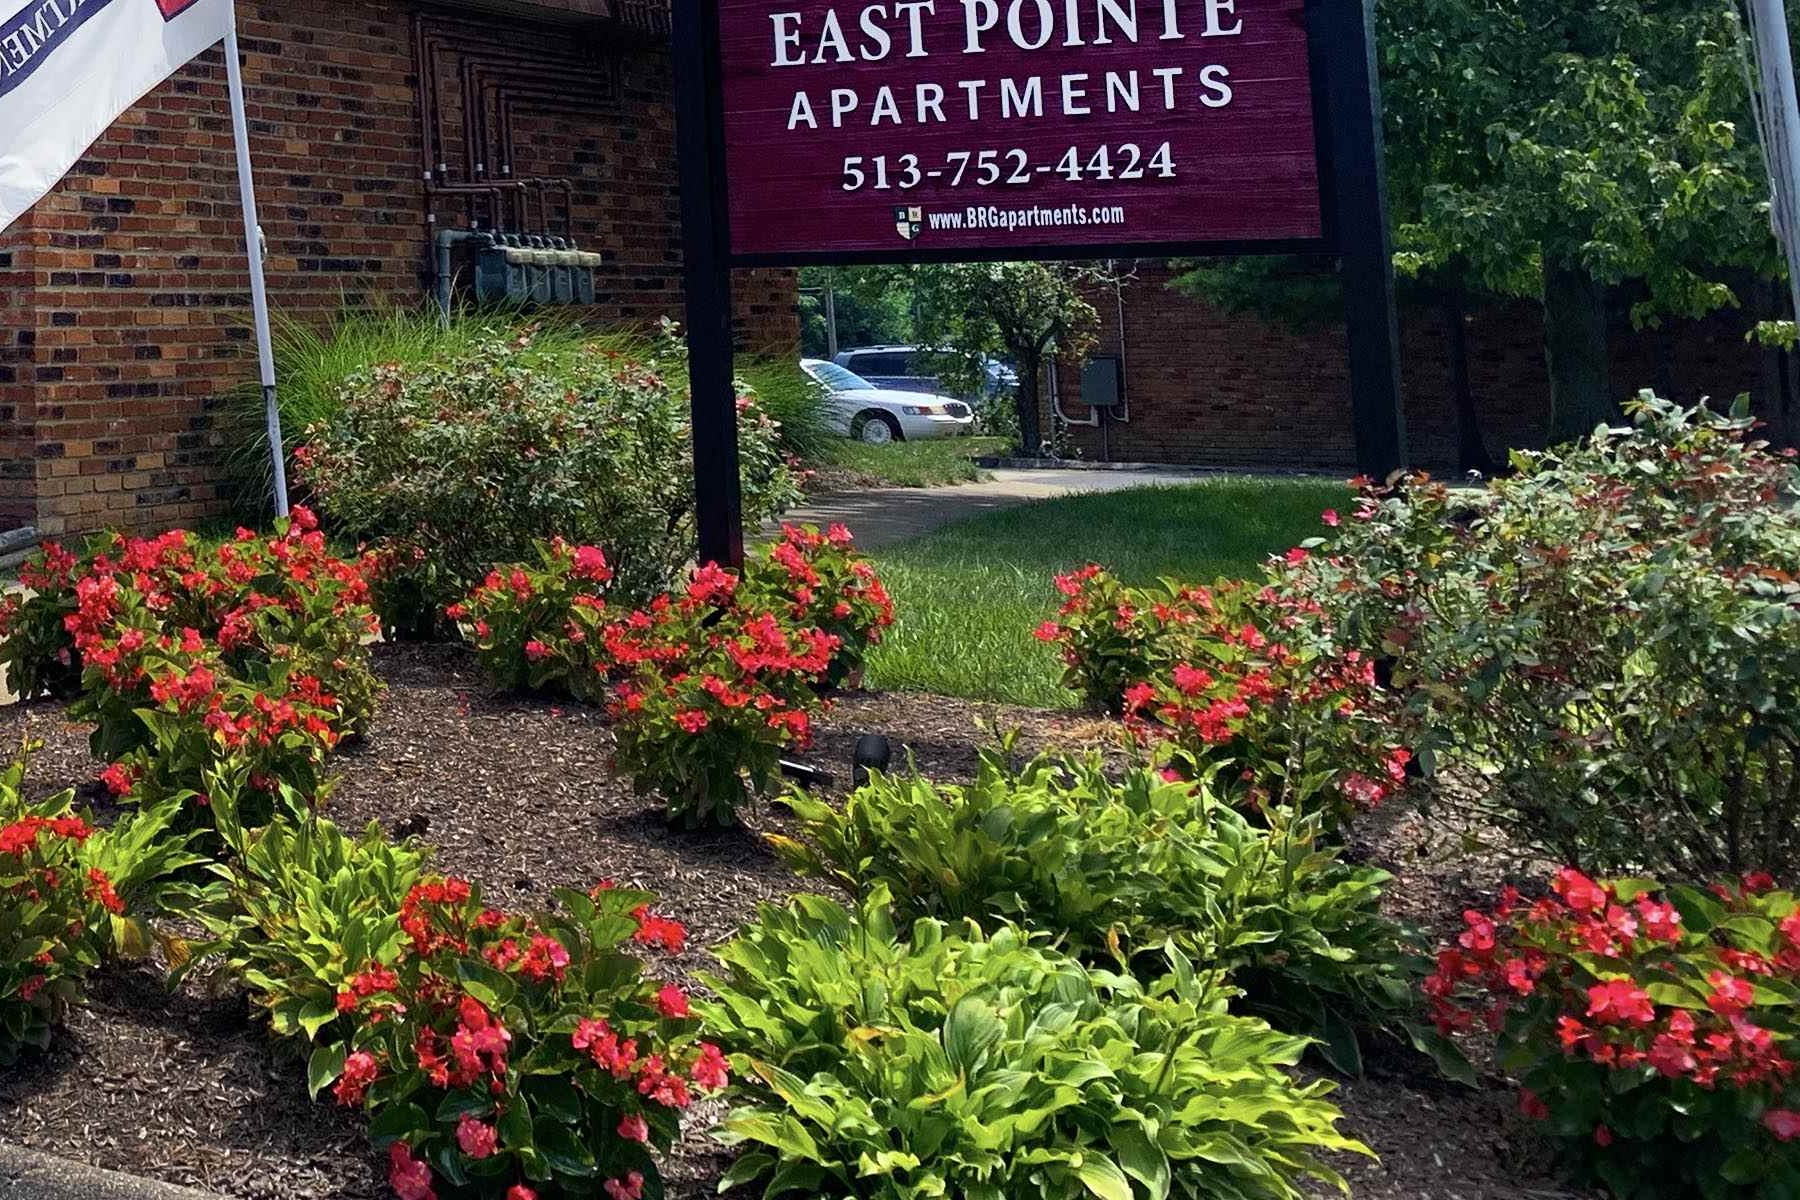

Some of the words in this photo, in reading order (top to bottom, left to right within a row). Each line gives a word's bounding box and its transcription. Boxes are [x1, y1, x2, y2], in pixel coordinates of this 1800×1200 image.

[769, 0, 936, 67] EAST
[787, 64, 1233, 130] APARTMENTS
[842, 141, 1176, 191] 513-752-4424
[928, 204, 1124, 231] www.BRGapartments.com
